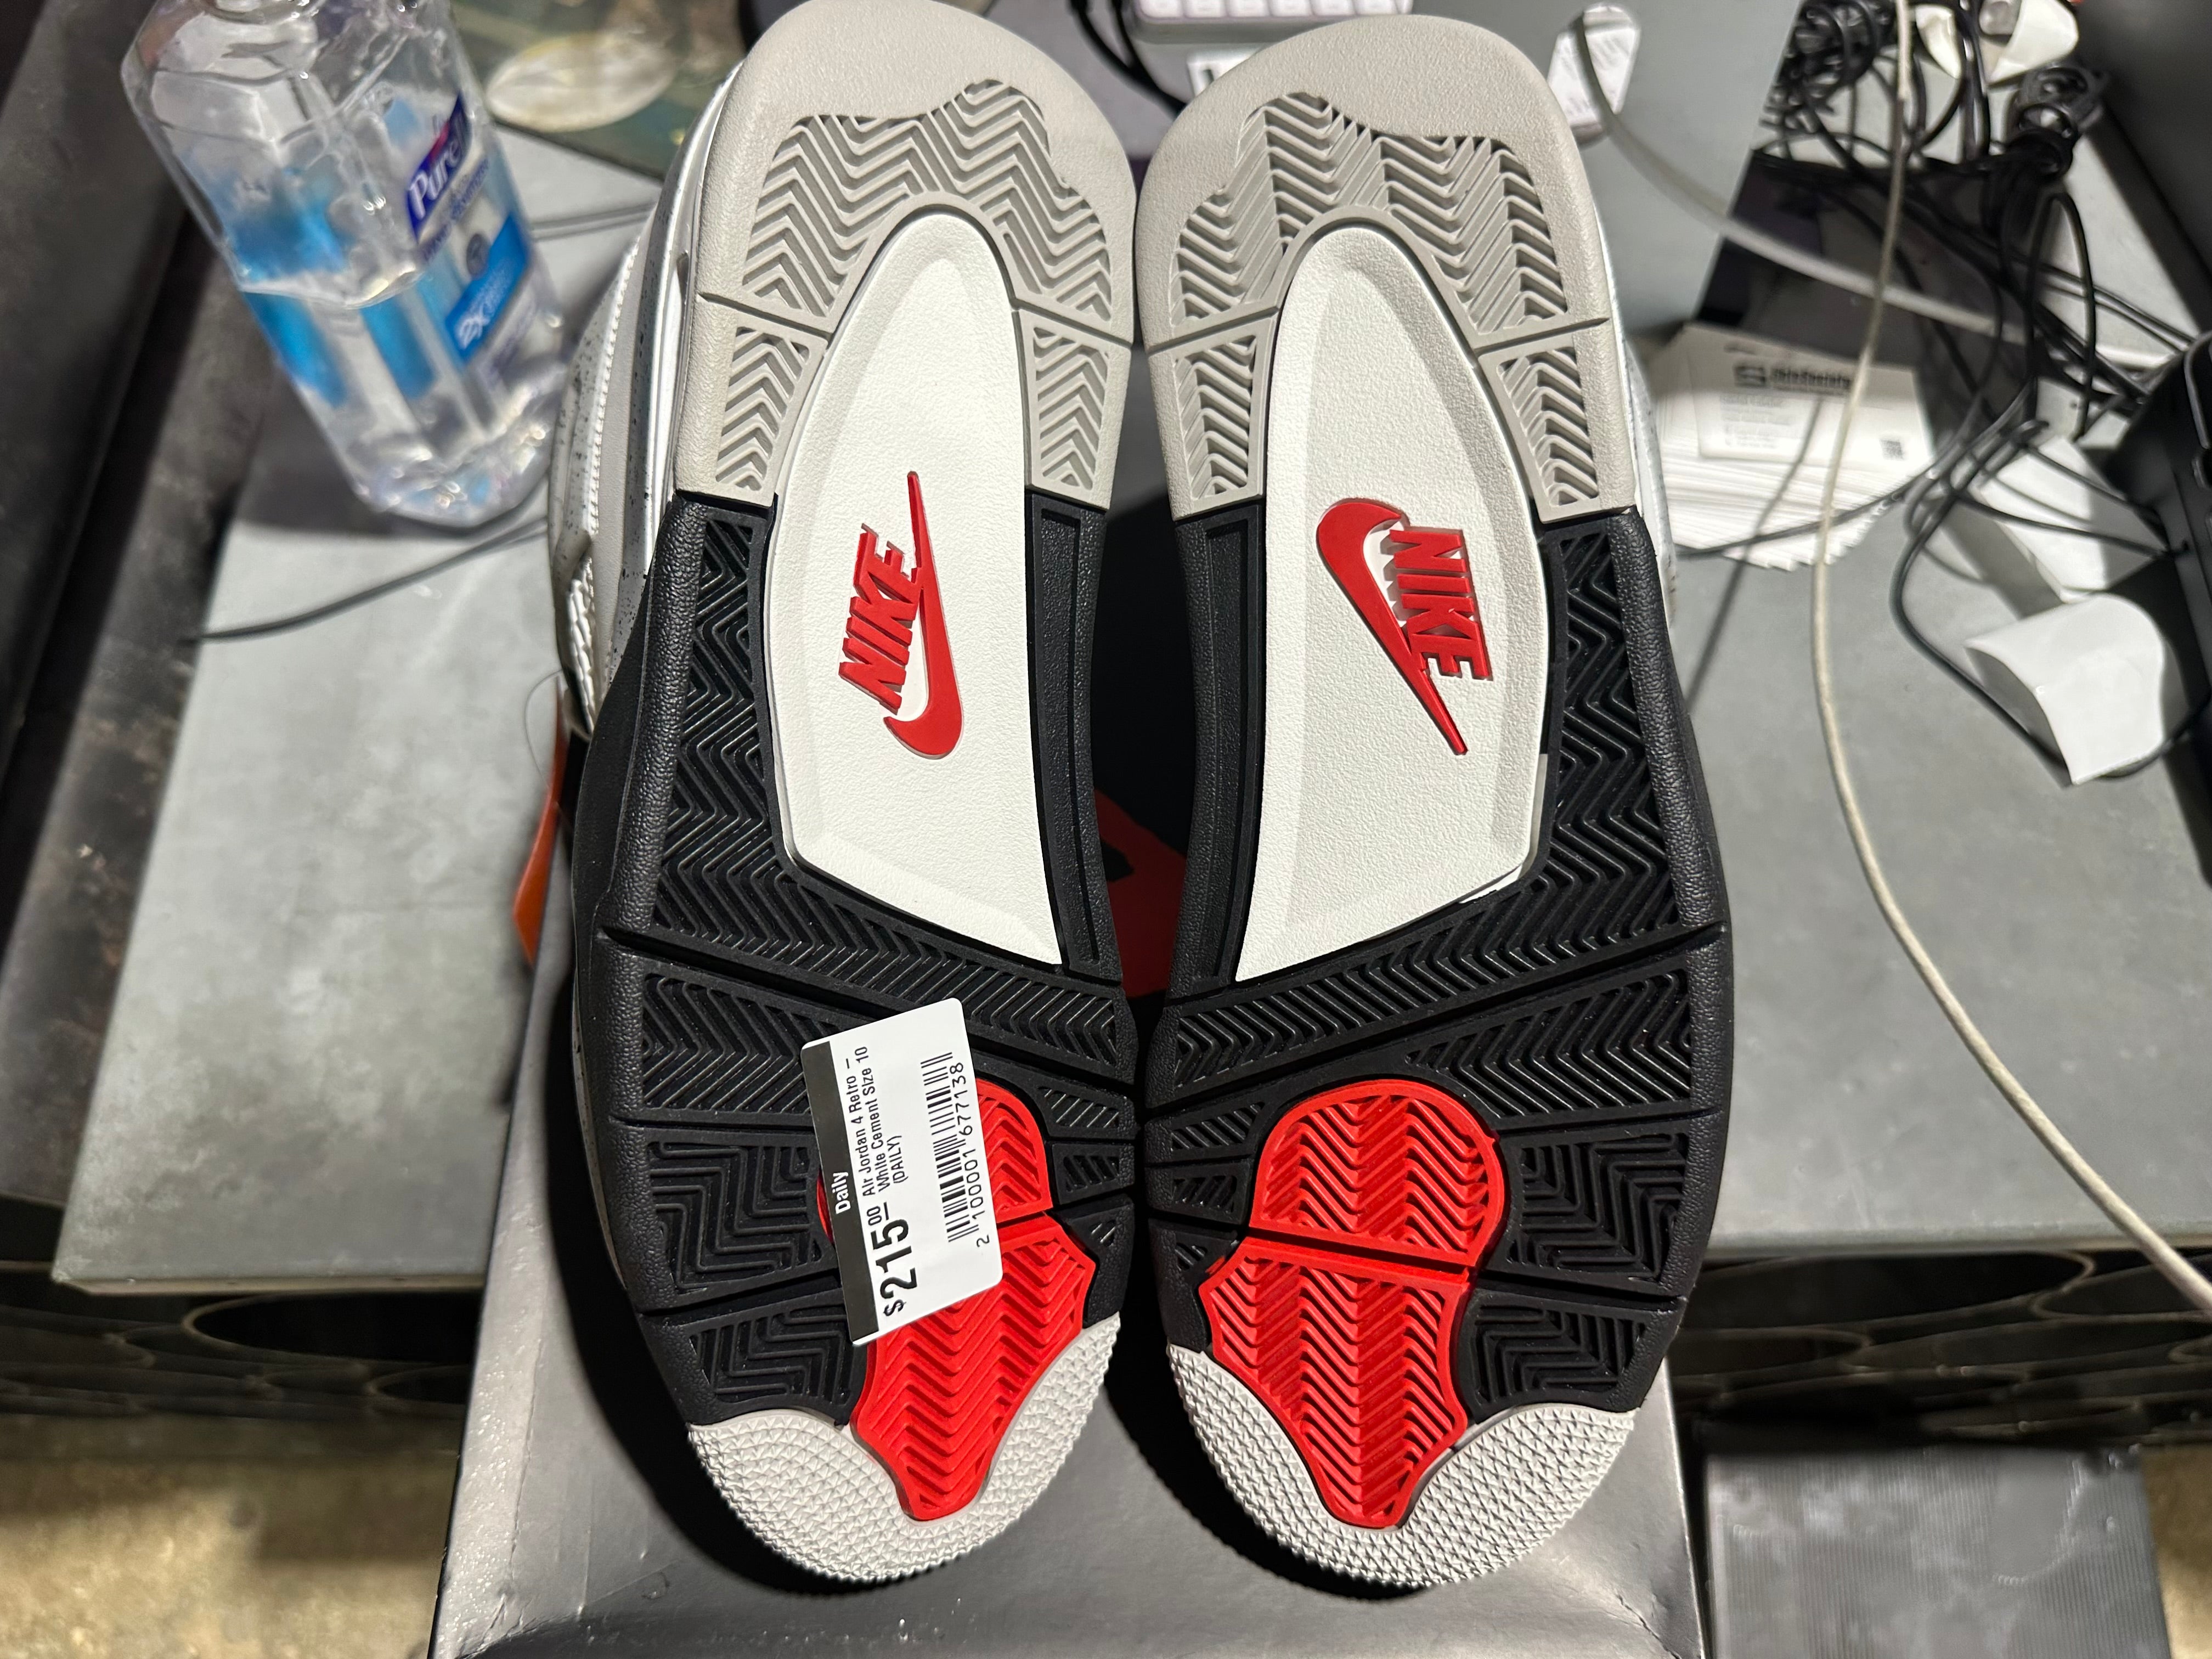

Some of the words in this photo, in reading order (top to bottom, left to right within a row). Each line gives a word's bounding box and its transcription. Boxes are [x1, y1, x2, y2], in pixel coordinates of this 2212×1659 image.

[838, 529, 923, 713] NIKE
[1389, 529, 1490, 678] NIKE
[854, 1046, 869, 1063] 10
[846, 1076, 862, 1113] Retro
[862, 1068, 876, 1096] Size
[851, 1115, 863, 1124] 4
[865, 1098, 884, 1149] Cement
[855, 1128, 871, 1173] Jordan
[887, 1136, 909, 1183] (DAILY)
[831, 1171, 851, 1214] Daily
[862, 1178, 876, 1197] Air
[874, 1153, 890, 1192] White
